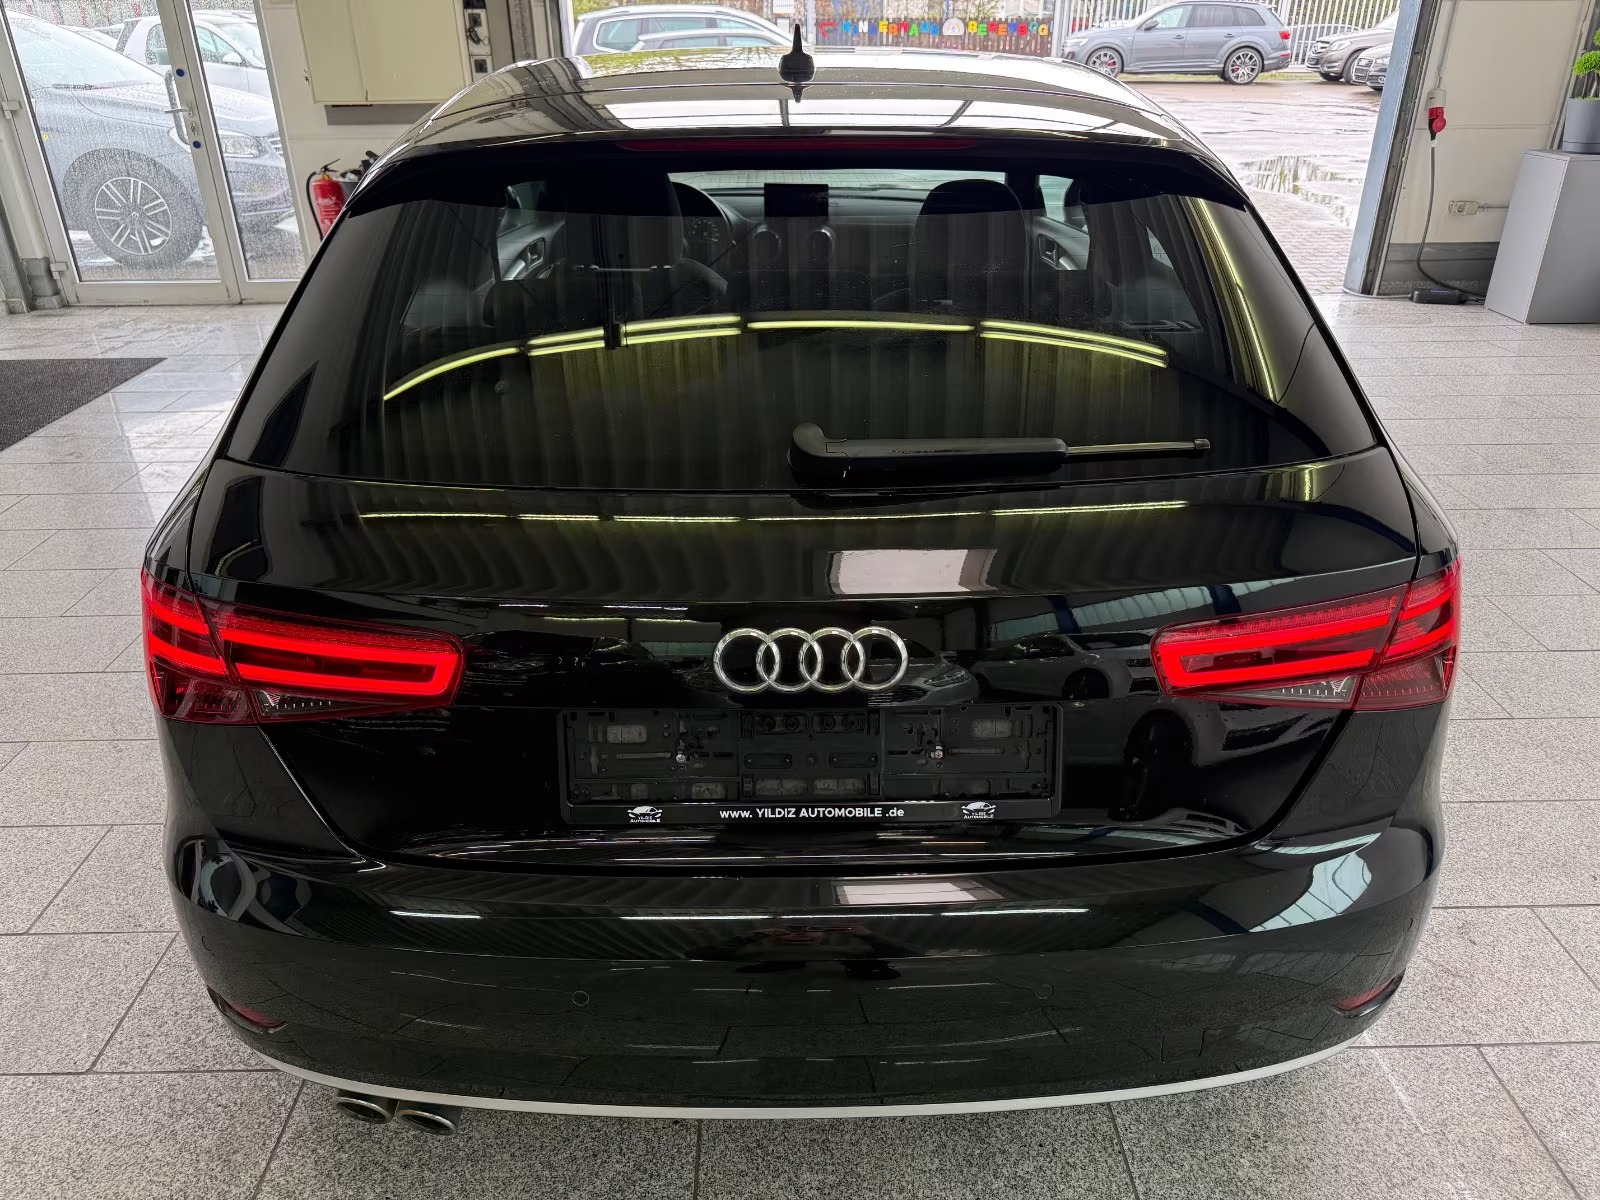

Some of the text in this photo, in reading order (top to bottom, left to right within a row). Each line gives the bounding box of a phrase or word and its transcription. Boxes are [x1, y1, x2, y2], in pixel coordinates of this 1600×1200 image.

[719, 807, 905, 819] www. YILDIZ AUTOMOBILE .de
